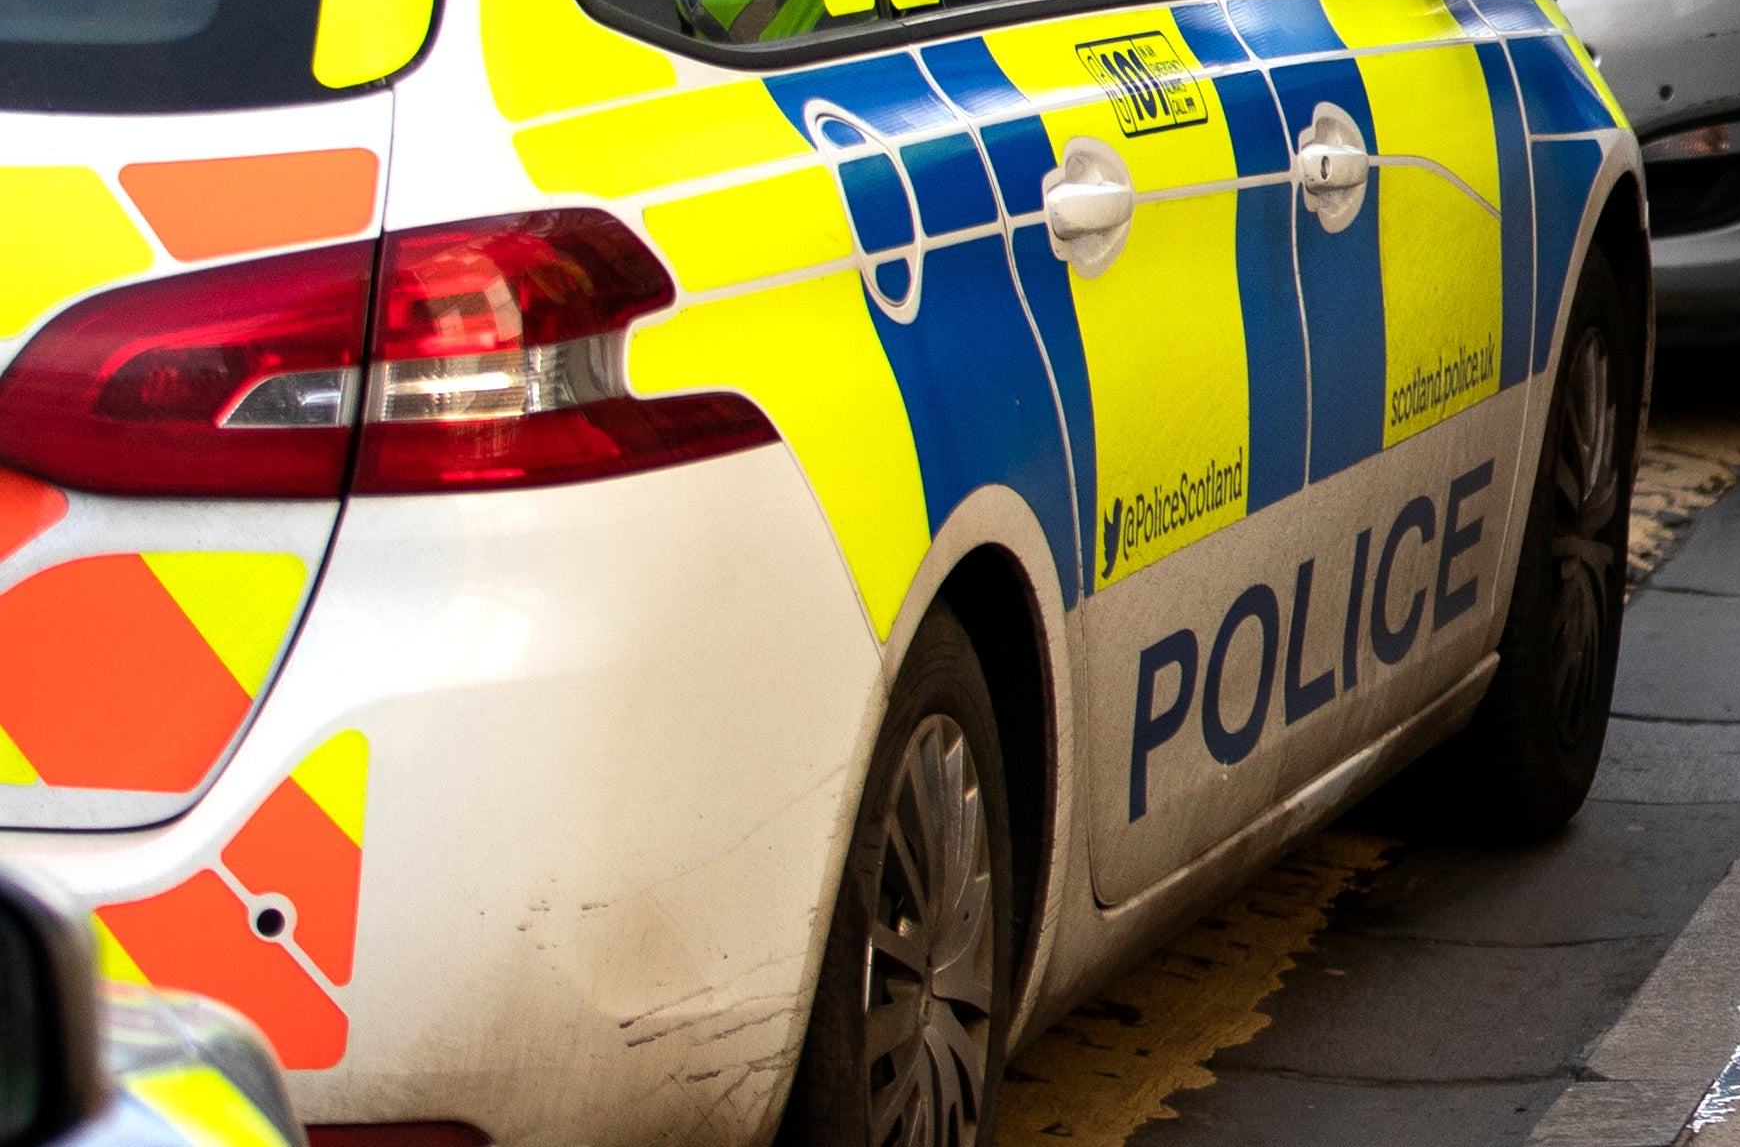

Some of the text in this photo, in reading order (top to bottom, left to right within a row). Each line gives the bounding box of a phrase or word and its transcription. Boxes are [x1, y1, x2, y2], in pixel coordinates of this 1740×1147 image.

[1100, 48, 1170, 121] 101
[1123, 446, 1243, 562] @PoliceScotland
[1128, 457, 1496, 825] POLICE
